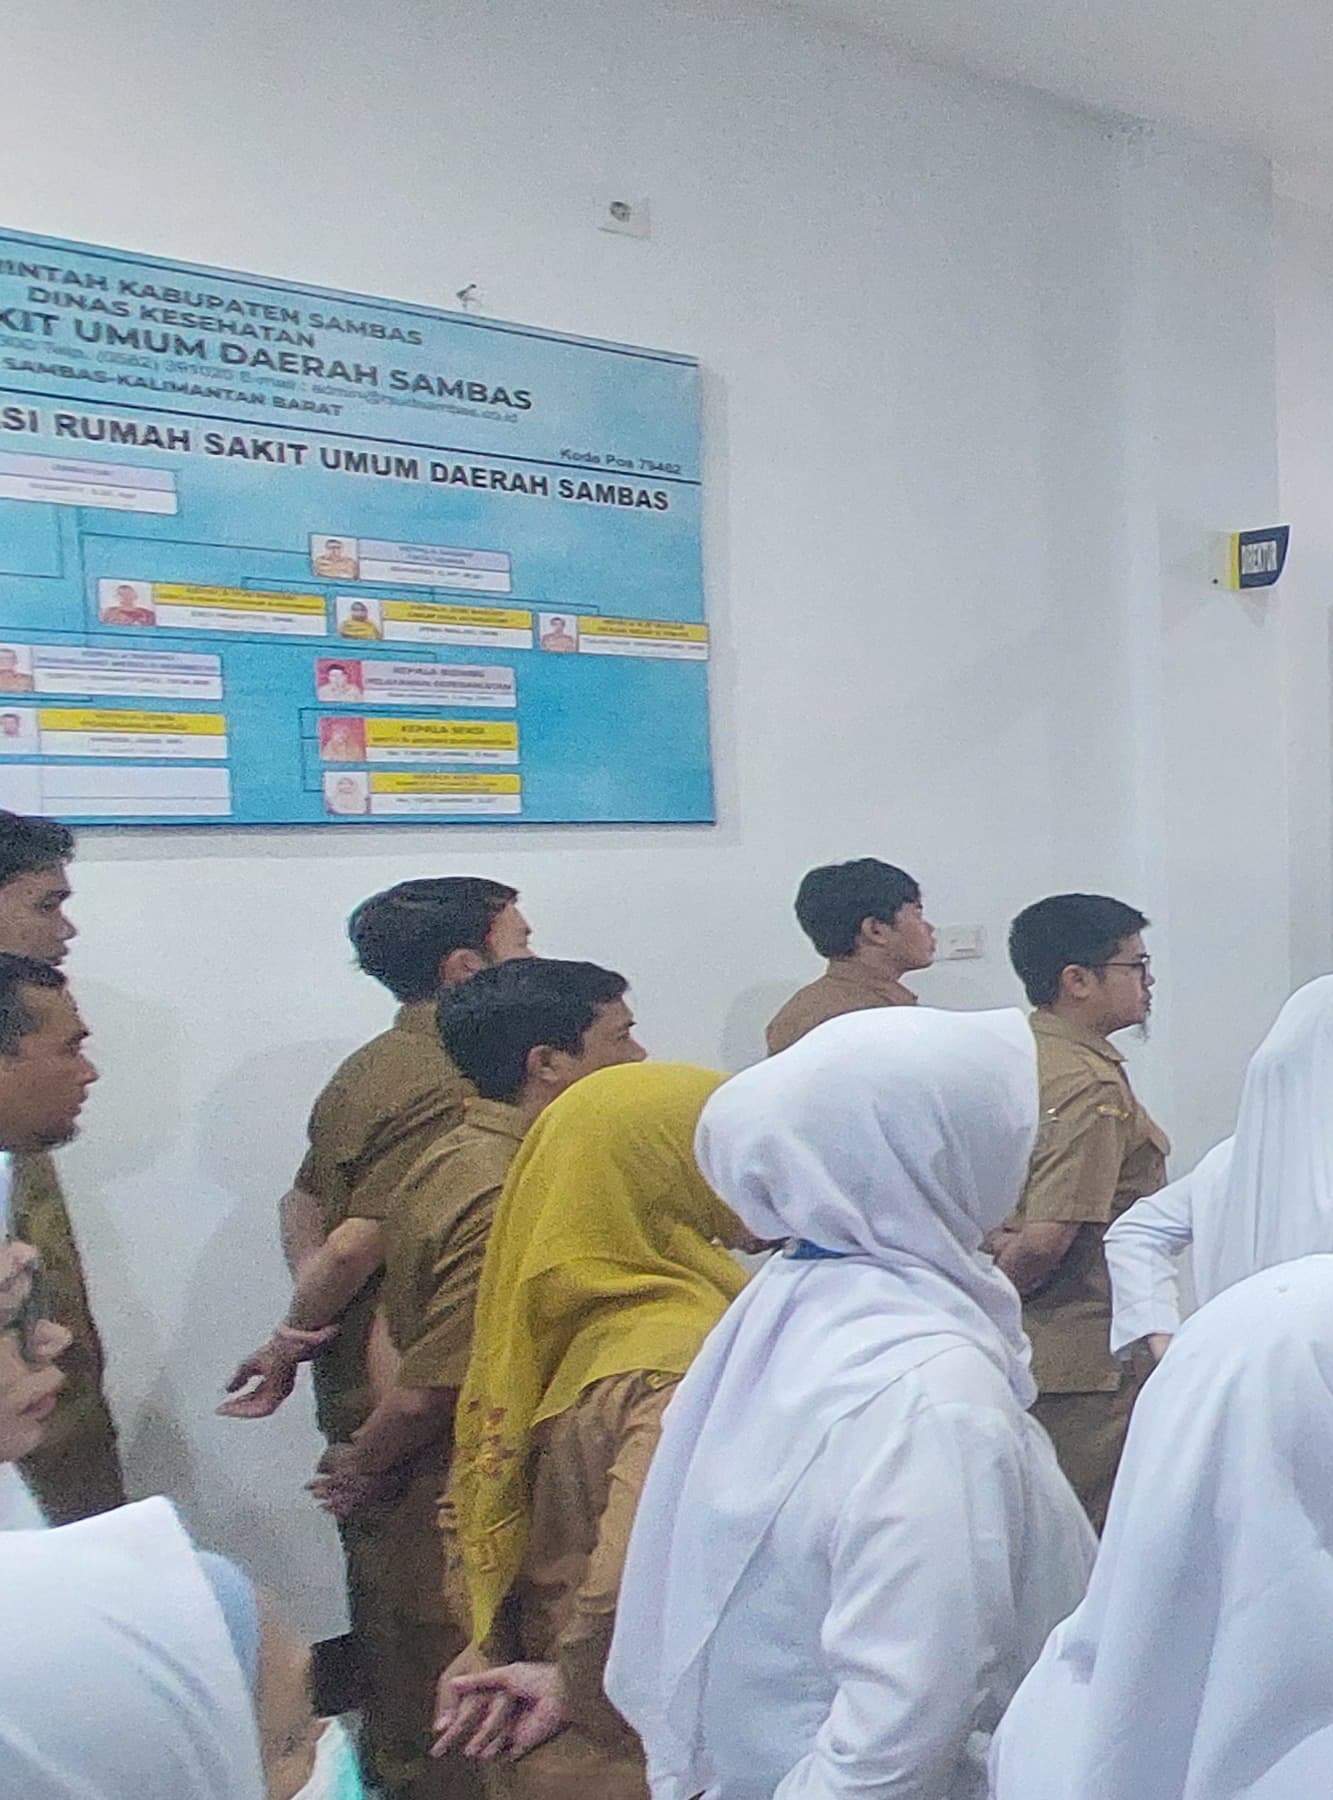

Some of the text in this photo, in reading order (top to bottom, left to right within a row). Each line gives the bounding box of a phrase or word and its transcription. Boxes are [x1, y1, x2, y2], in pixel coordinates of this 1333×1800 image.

[28, 286, 315, 348] DINAS KESEHATAN
[119, 279, 301, 325] KABUPATEN
[308, 312, 423, 346] SAMBAS
[75, 318, 206, 361] UMUM
[220, 341, 379, 387] DAERAH
[389, 368, 532, 411] SAMBAS
[272, 394, 344, 417] BARAT
[0, 407, 670, 511] SI RUMAH SAKIT UMUM DAERAH SAMBAS
[560, 449, 601, 464] Kode
